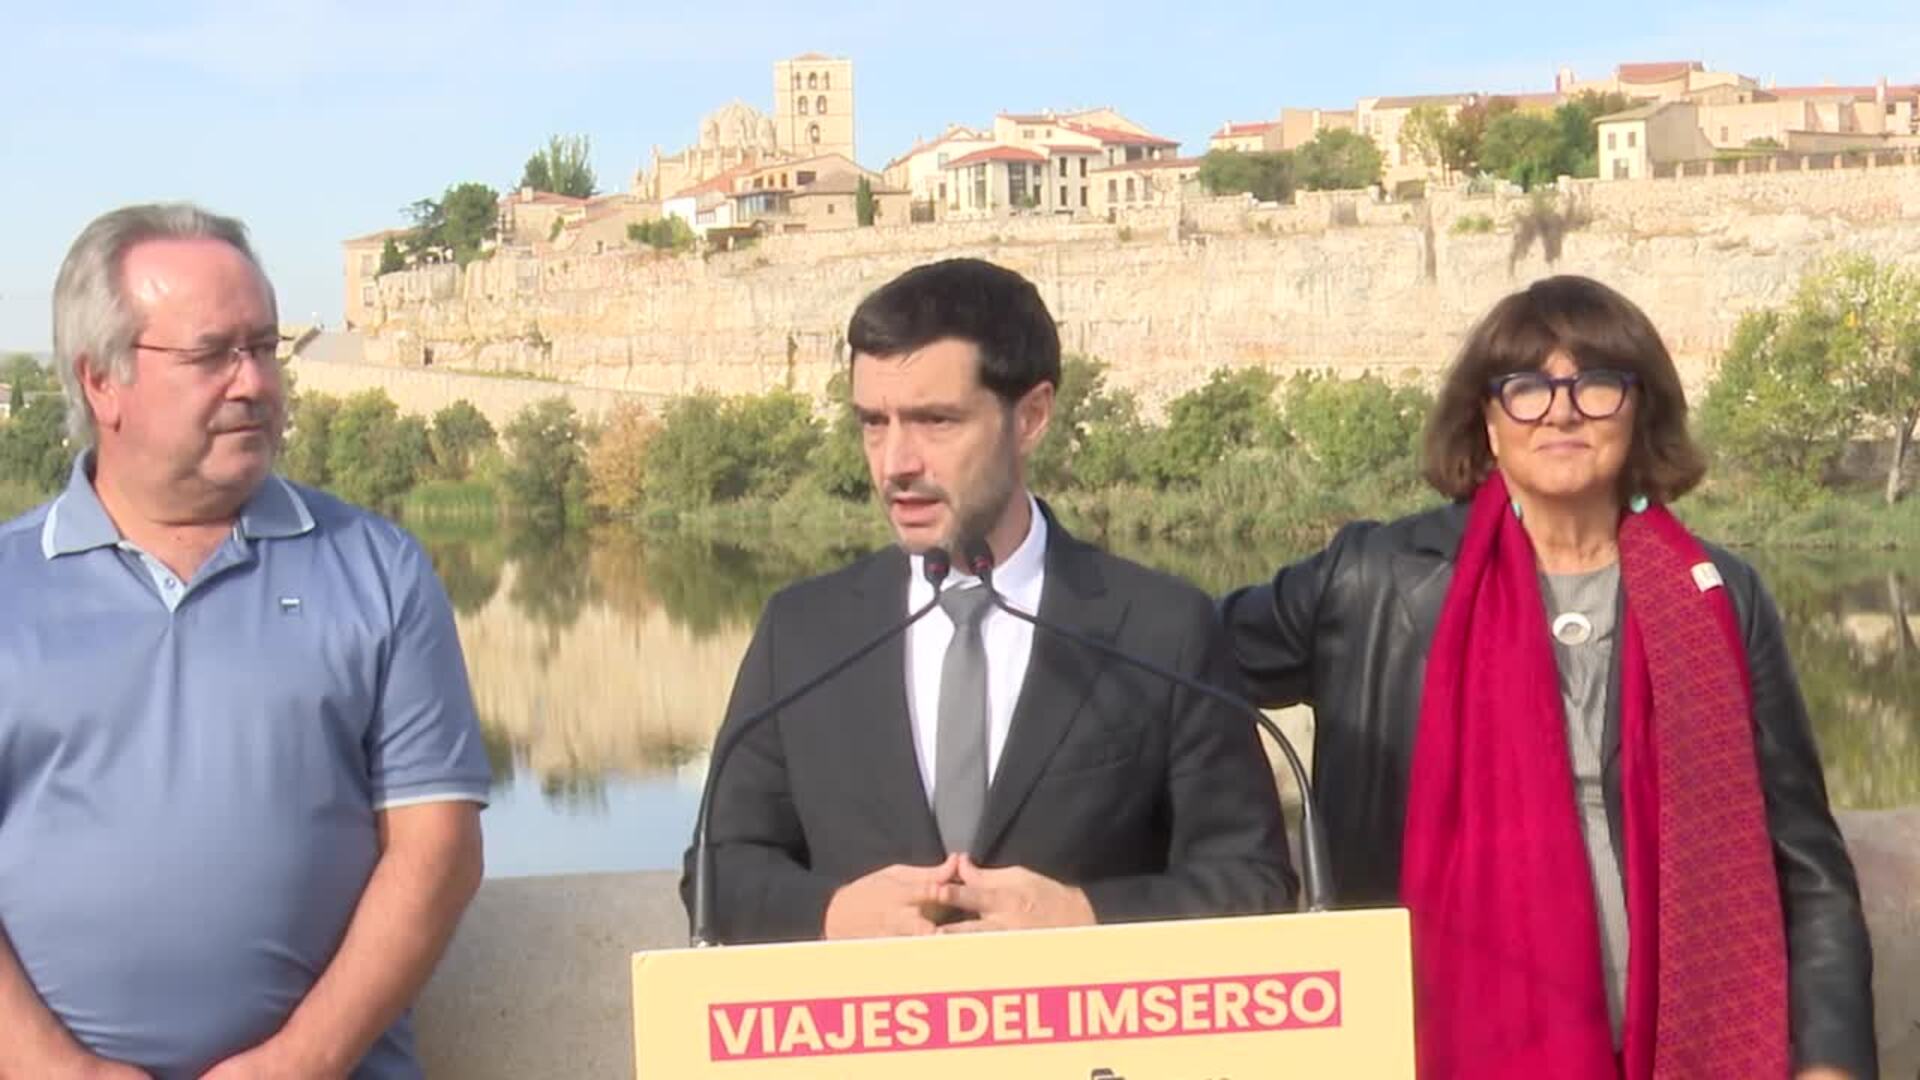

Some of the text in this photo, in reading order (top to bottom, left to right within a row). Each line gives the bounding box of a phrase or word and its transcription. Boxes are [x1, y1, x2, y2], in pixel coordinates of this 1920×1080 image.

[714, 977, 1336, 1055] VIAJES DEL IMSERSO
